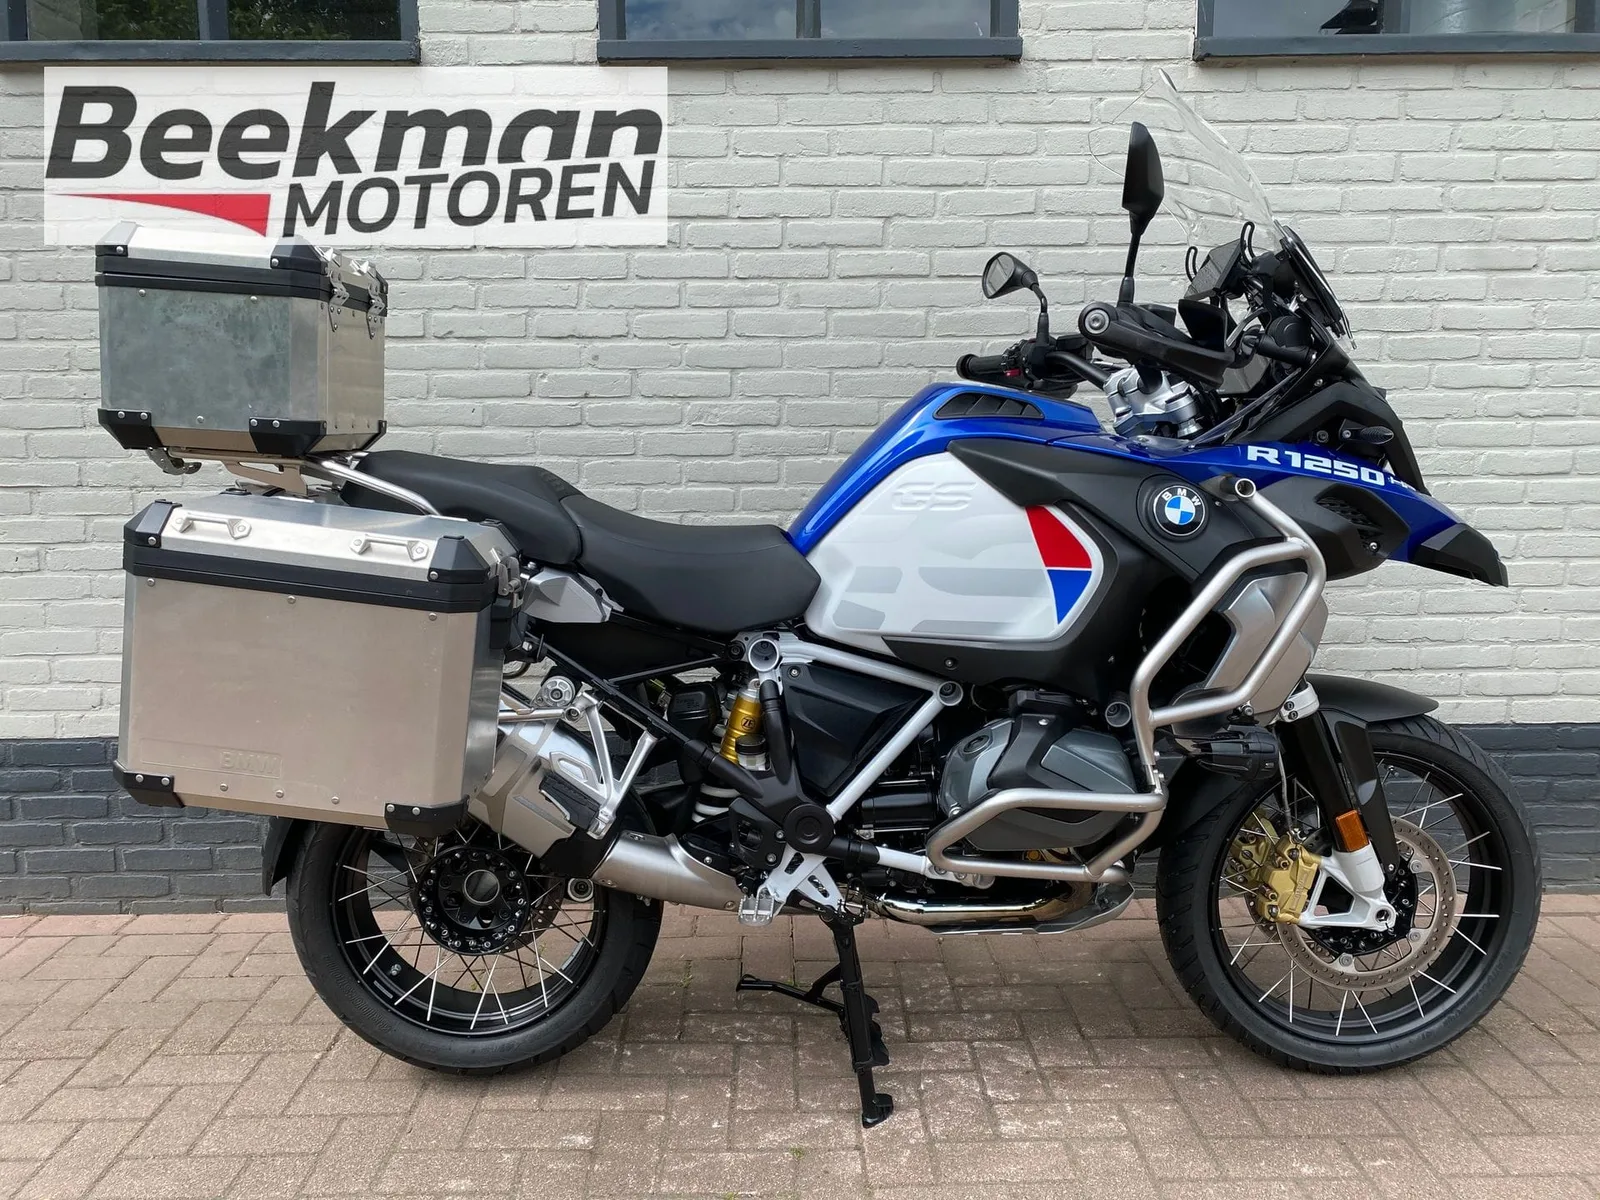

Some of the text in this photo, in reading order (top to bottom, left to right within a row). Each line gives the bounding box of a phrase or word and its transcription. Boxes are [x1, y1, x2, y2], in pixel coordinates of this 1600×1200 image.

[892, 481, 977, 511] GS
[1161, 487, 1202, 507] BMW
[221, 751, 279, 774] BMW
